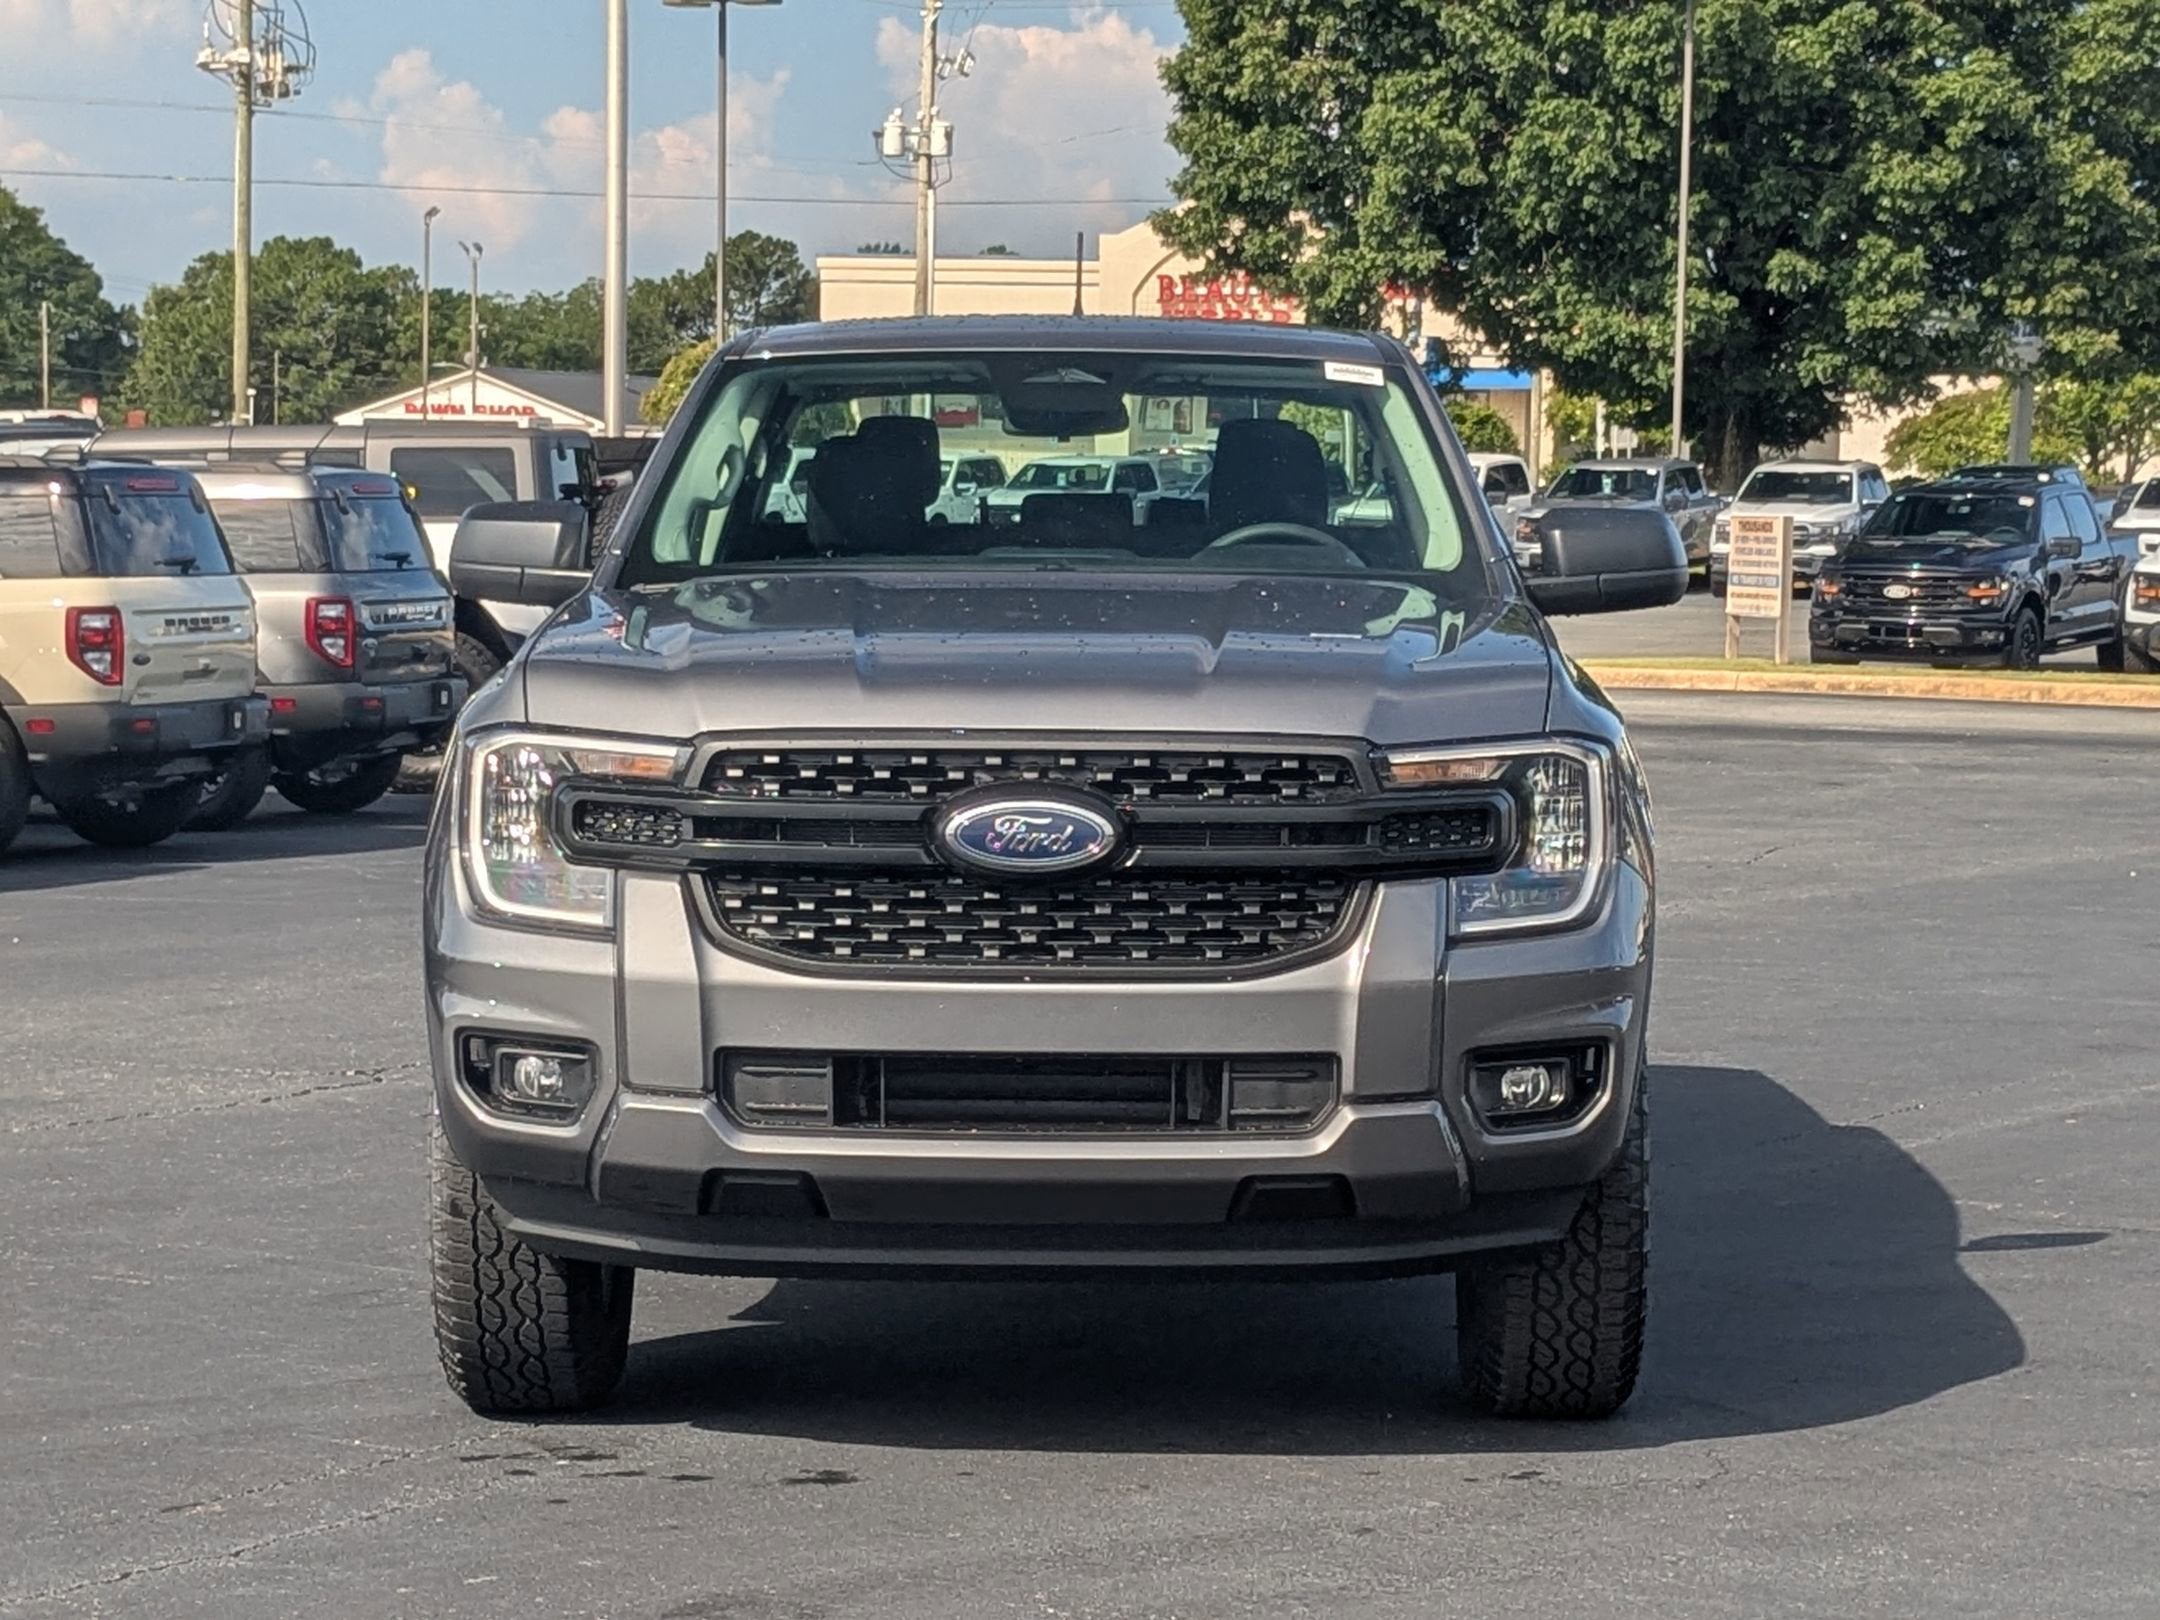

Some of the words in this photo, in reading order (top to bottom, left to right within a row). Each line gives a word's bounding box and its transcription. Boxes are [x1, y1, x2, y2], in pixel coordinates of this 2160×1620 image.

[1157, 270, 1300, 312] BEAU
[404, 402, 465, 414] PAWN
[474, 405, 538, 416] SHOP
[985, 815, 1074, 852] Ford
